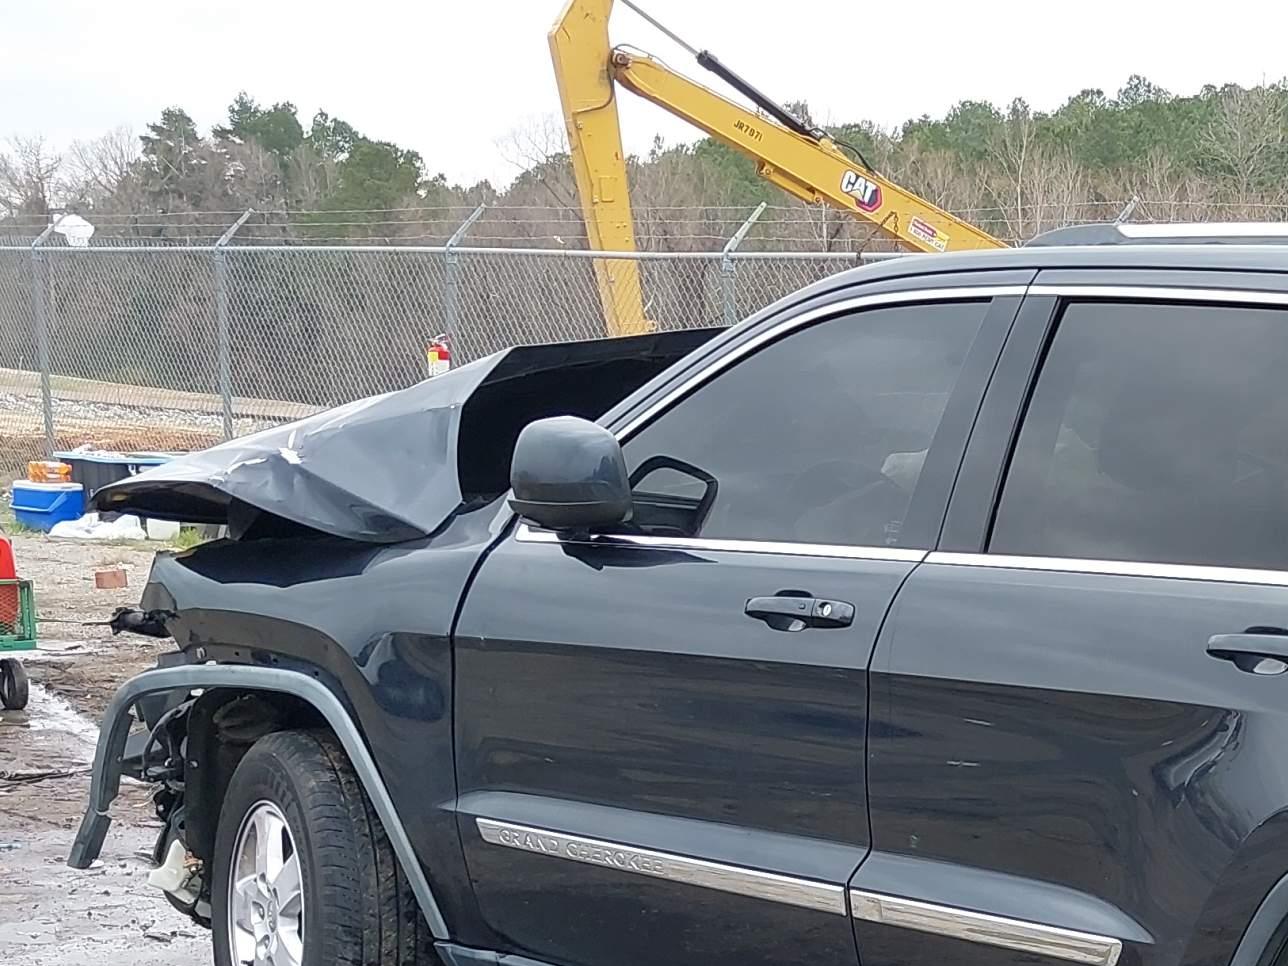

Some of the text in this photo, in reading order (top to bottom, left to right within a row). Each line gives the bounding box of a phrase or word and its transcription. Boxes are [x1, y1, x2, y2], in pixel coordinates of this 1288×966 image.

[841, 170, 878, 204] CAT
[499, 828, 665, 875] GRAND CHEROKEE
